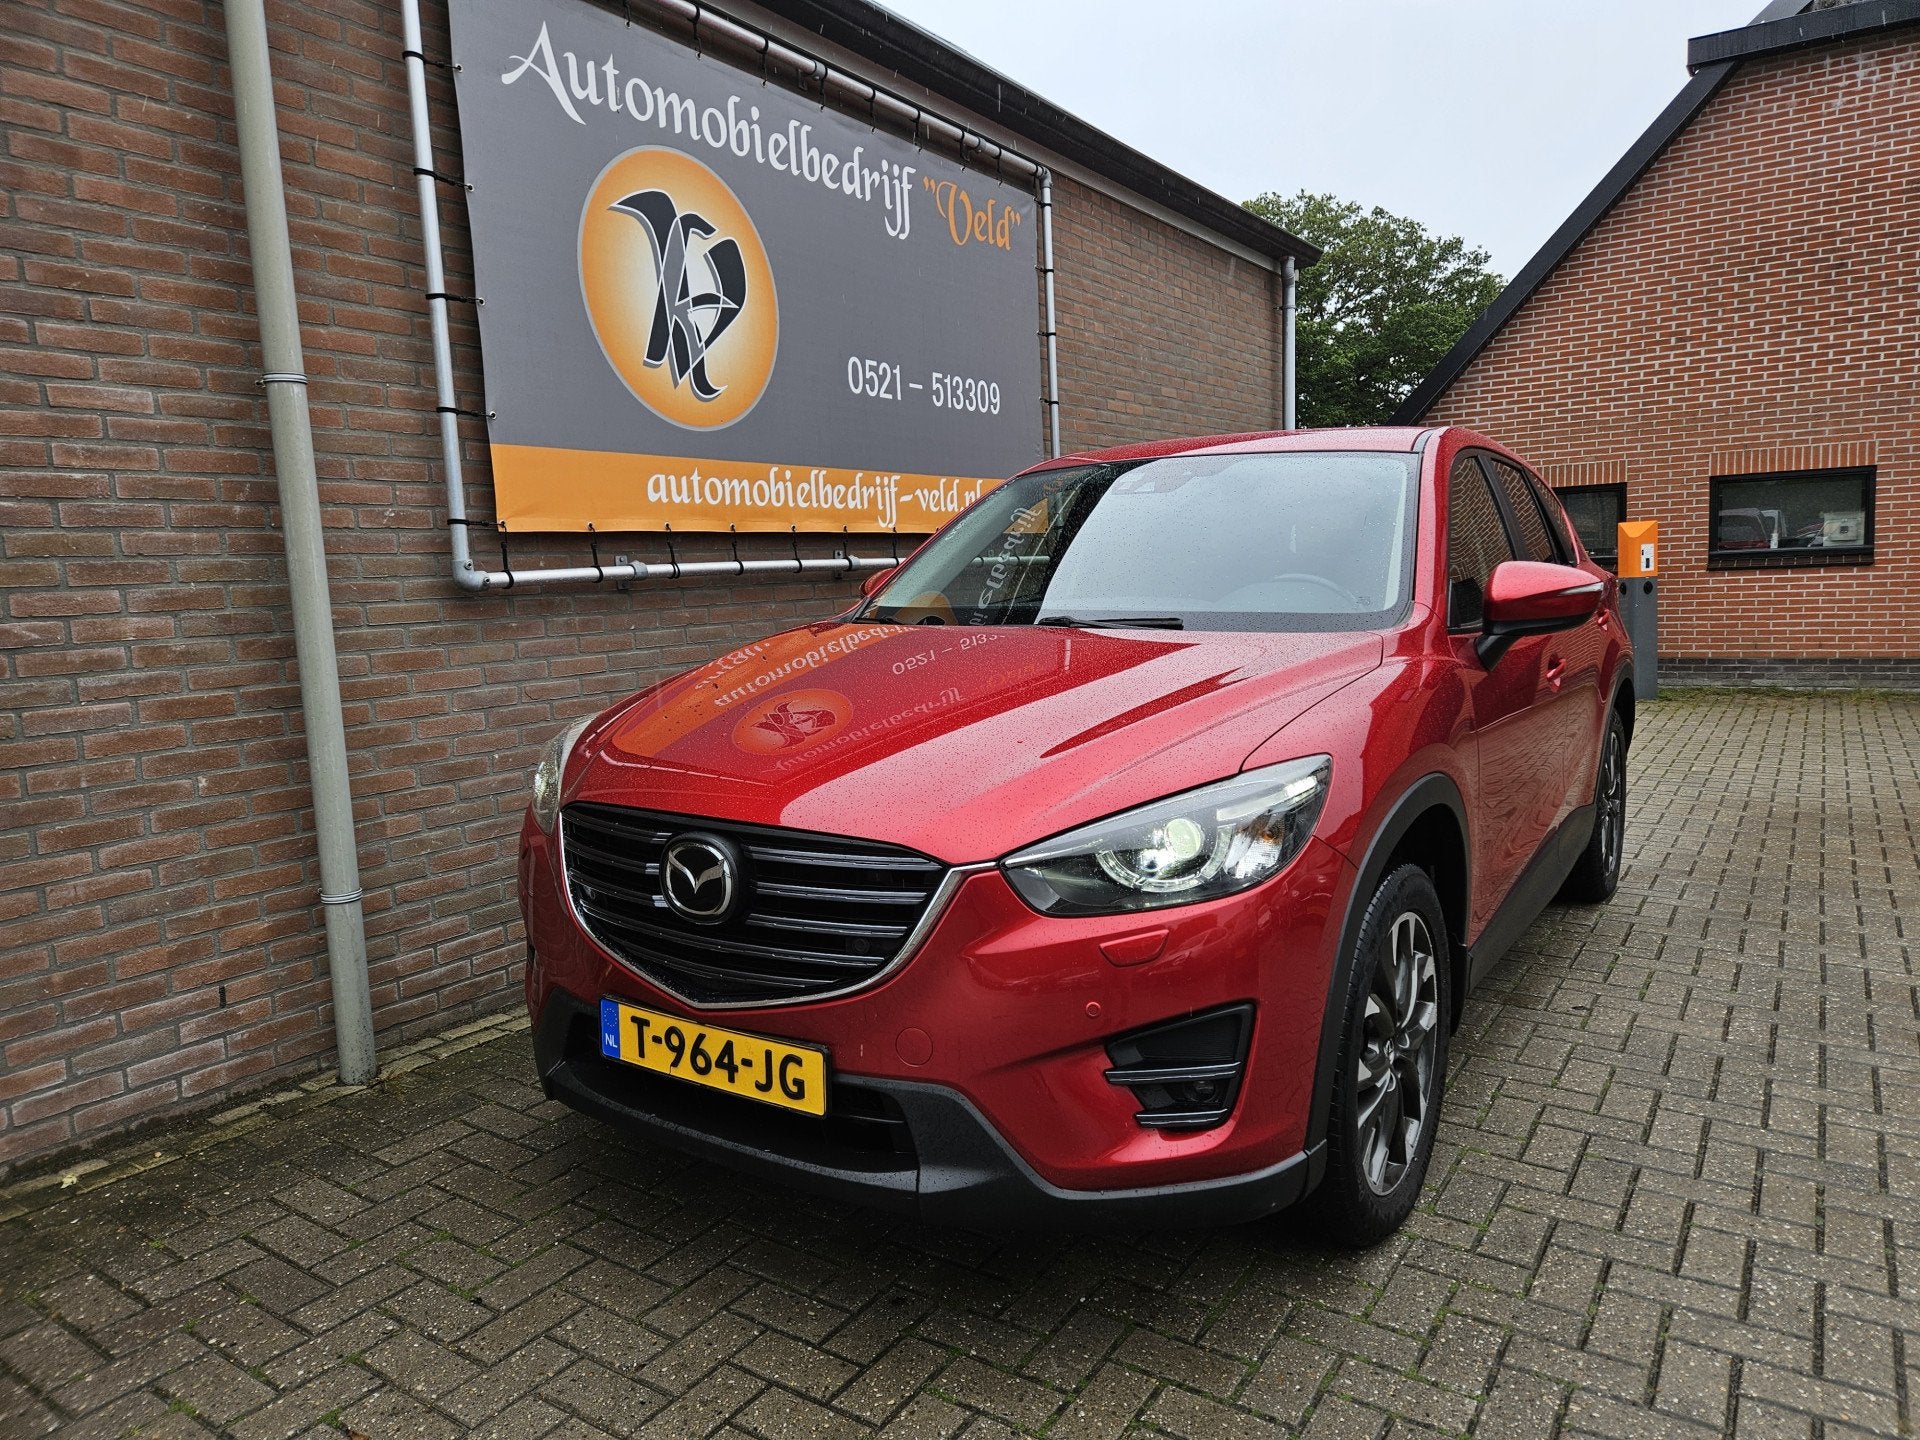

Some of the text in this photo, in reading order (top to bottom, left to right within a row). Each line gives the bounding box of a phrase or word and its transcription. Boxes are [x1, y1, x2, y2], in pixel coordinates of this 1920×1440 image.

[501, 20, 917, 240] Automobielbedrijf
[847, 356, 902, 400] 0521
[932, 373, 1001, 415] 513309
[604, 1032, 618, 1049] NL
[630, 1015, 806, 1101] T-964-JG
